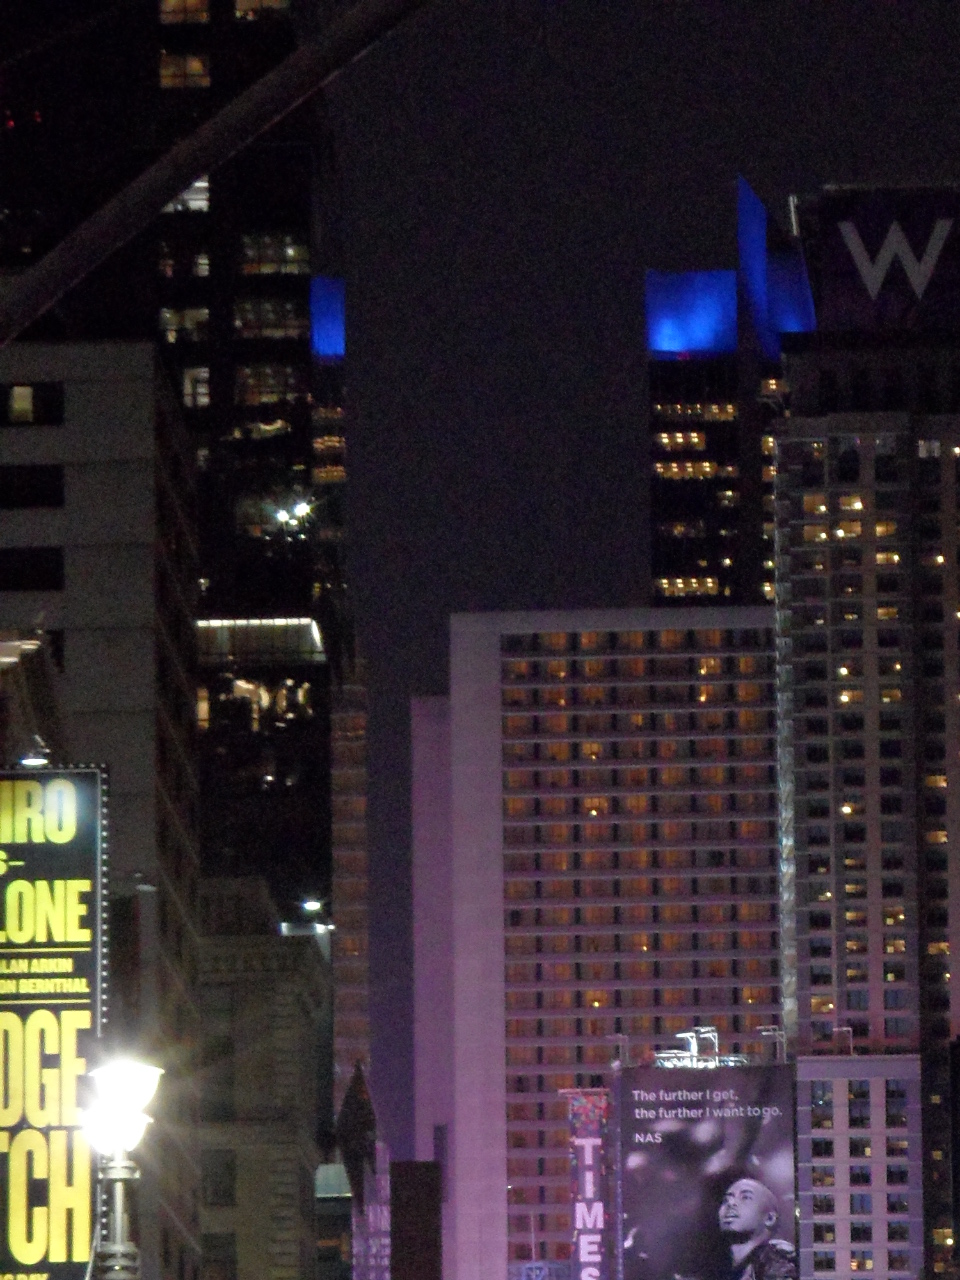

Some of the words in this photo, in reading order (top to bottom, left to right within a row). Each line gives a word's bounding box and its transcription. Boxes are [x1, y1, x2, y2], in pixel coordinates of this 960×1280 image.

[837, 218, 954, 300] W
[632, 1090, 657, 1101] The
[659, 1089, 704, 1101] further
[634, 1108, 656, 1119] the
[658, 1107, 704, 1119] further
[713, 1107, 745, 1118] want
[747, 1106, 761, 1117] to
[635, 1132, 663, 1144] NAS
